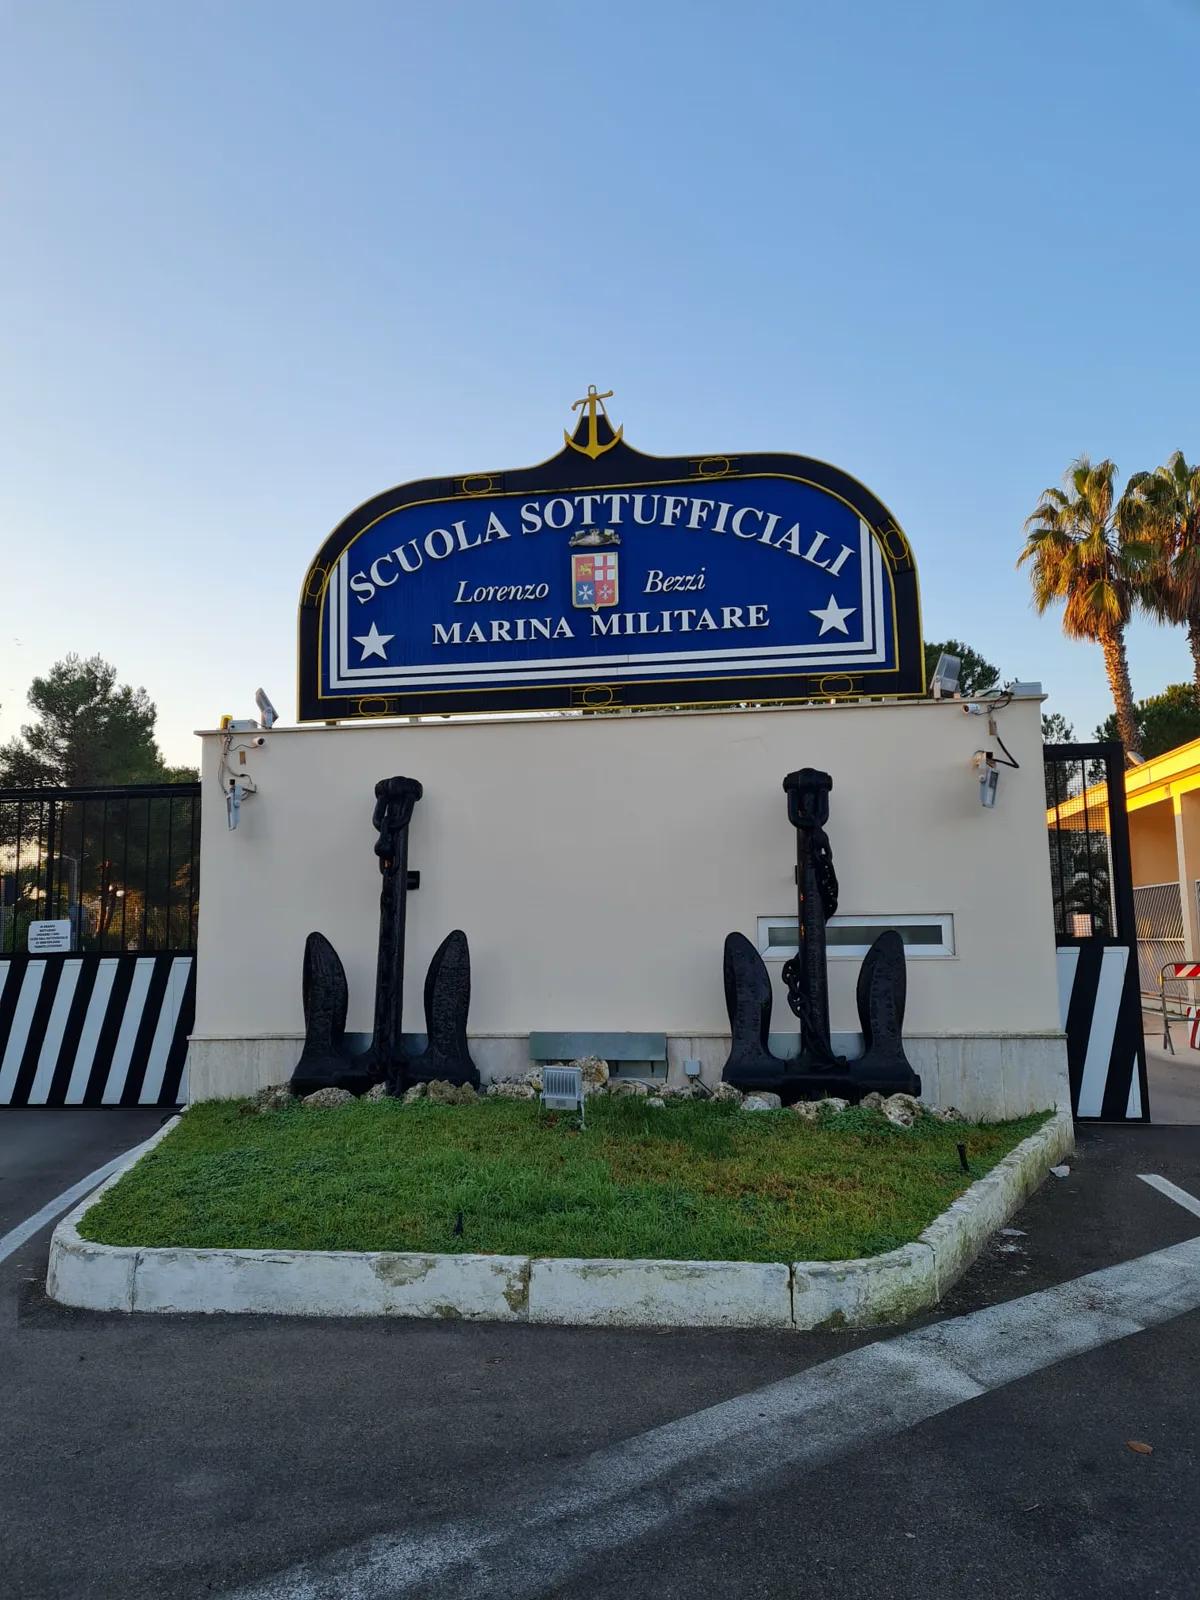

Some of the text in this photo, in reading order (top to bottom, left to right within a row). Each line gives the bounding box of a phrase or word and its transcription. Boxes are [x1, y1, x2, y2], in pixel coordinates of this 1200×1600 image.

[349, 494, 855, 604] SCUOLA SOTTUFFICIALI
[454, 567, 706, 603] Lorenzo Bezzi
[432, 604, 769, 645] MARINA MILITARE
